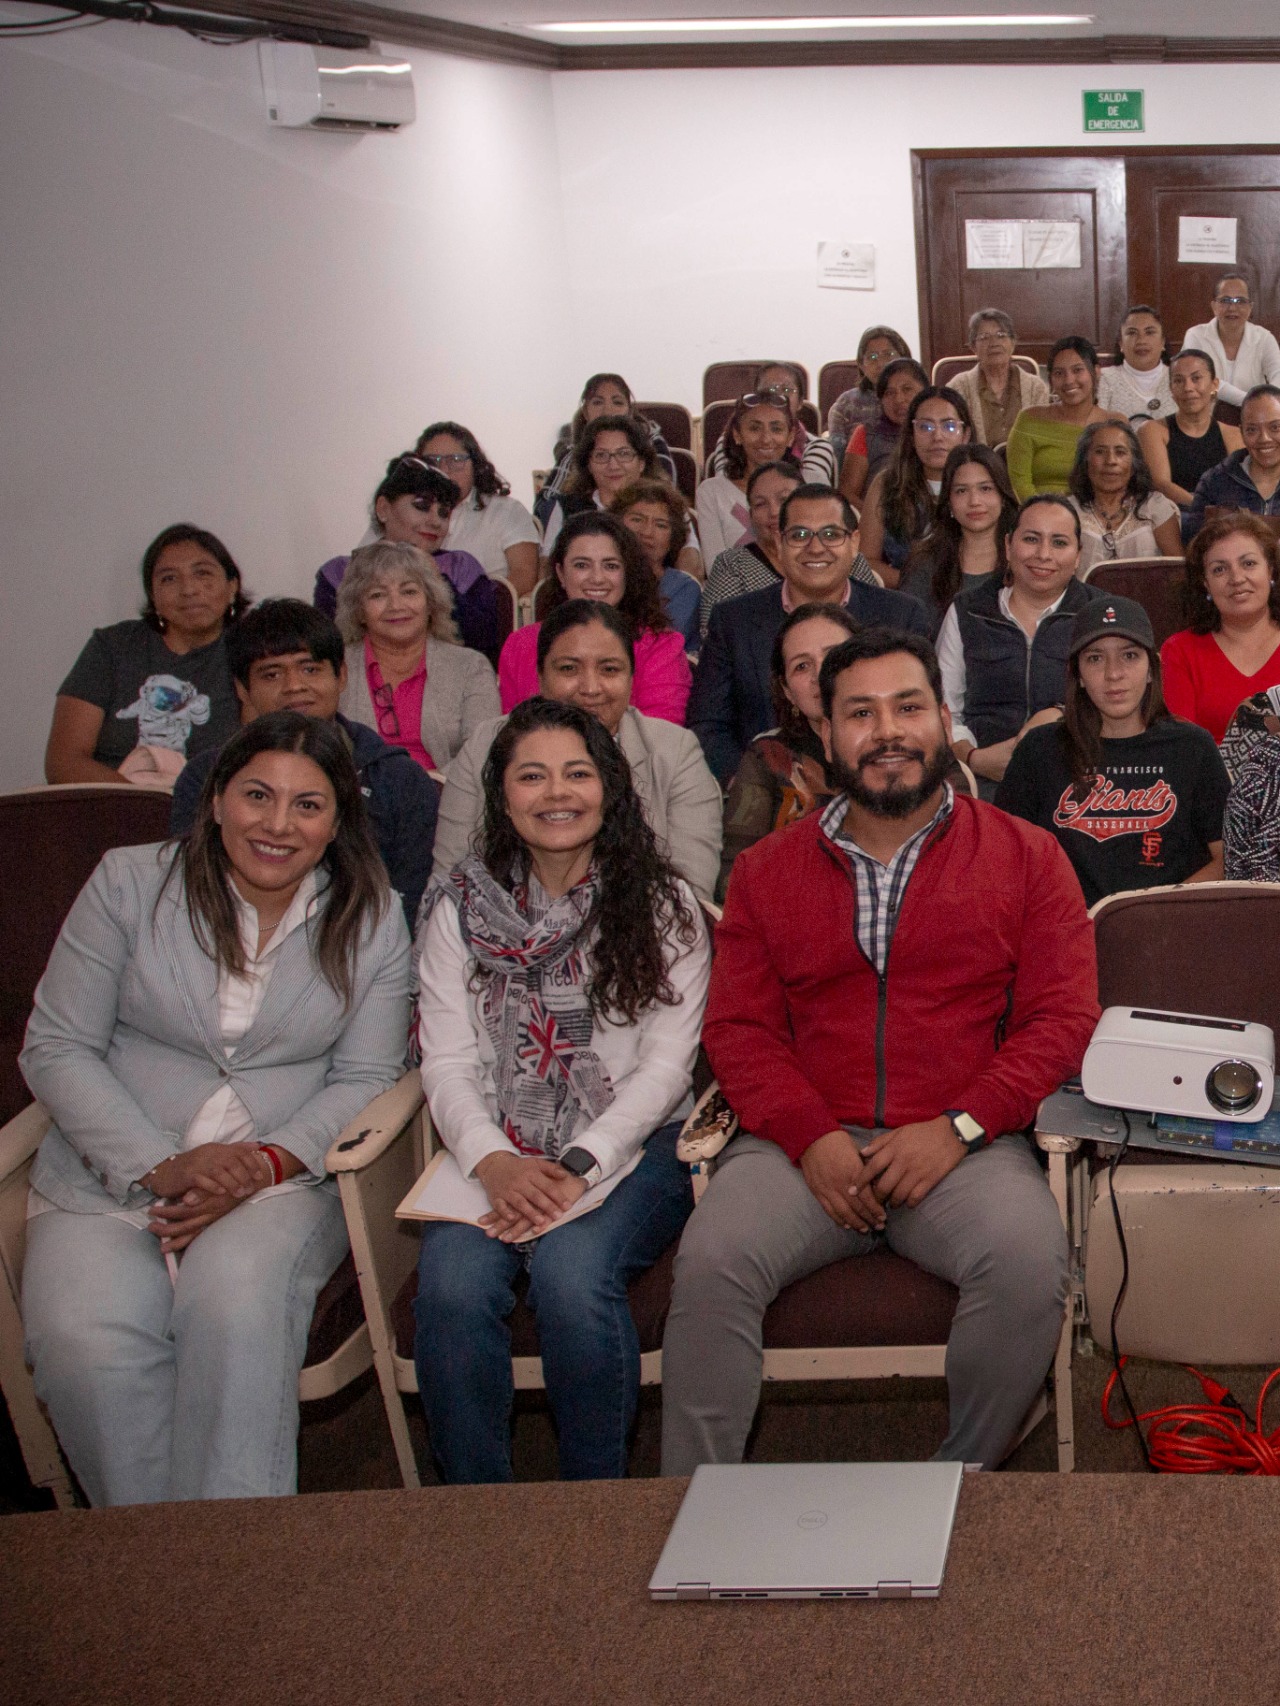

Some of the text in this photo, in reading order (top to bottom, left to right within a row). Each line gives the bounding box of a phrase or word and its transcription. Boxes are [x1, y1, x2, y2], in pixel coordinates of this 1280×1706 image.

[1098, 93, 1129, 103] SALIDA
[1107, 106, 1119, 116] DE
[1088, 120, 1139, 129] EMERGENCIA
[1106, 766, 1164, 774] FRANCISCO
[1087, 821, 1150, 829] BASEBALL
